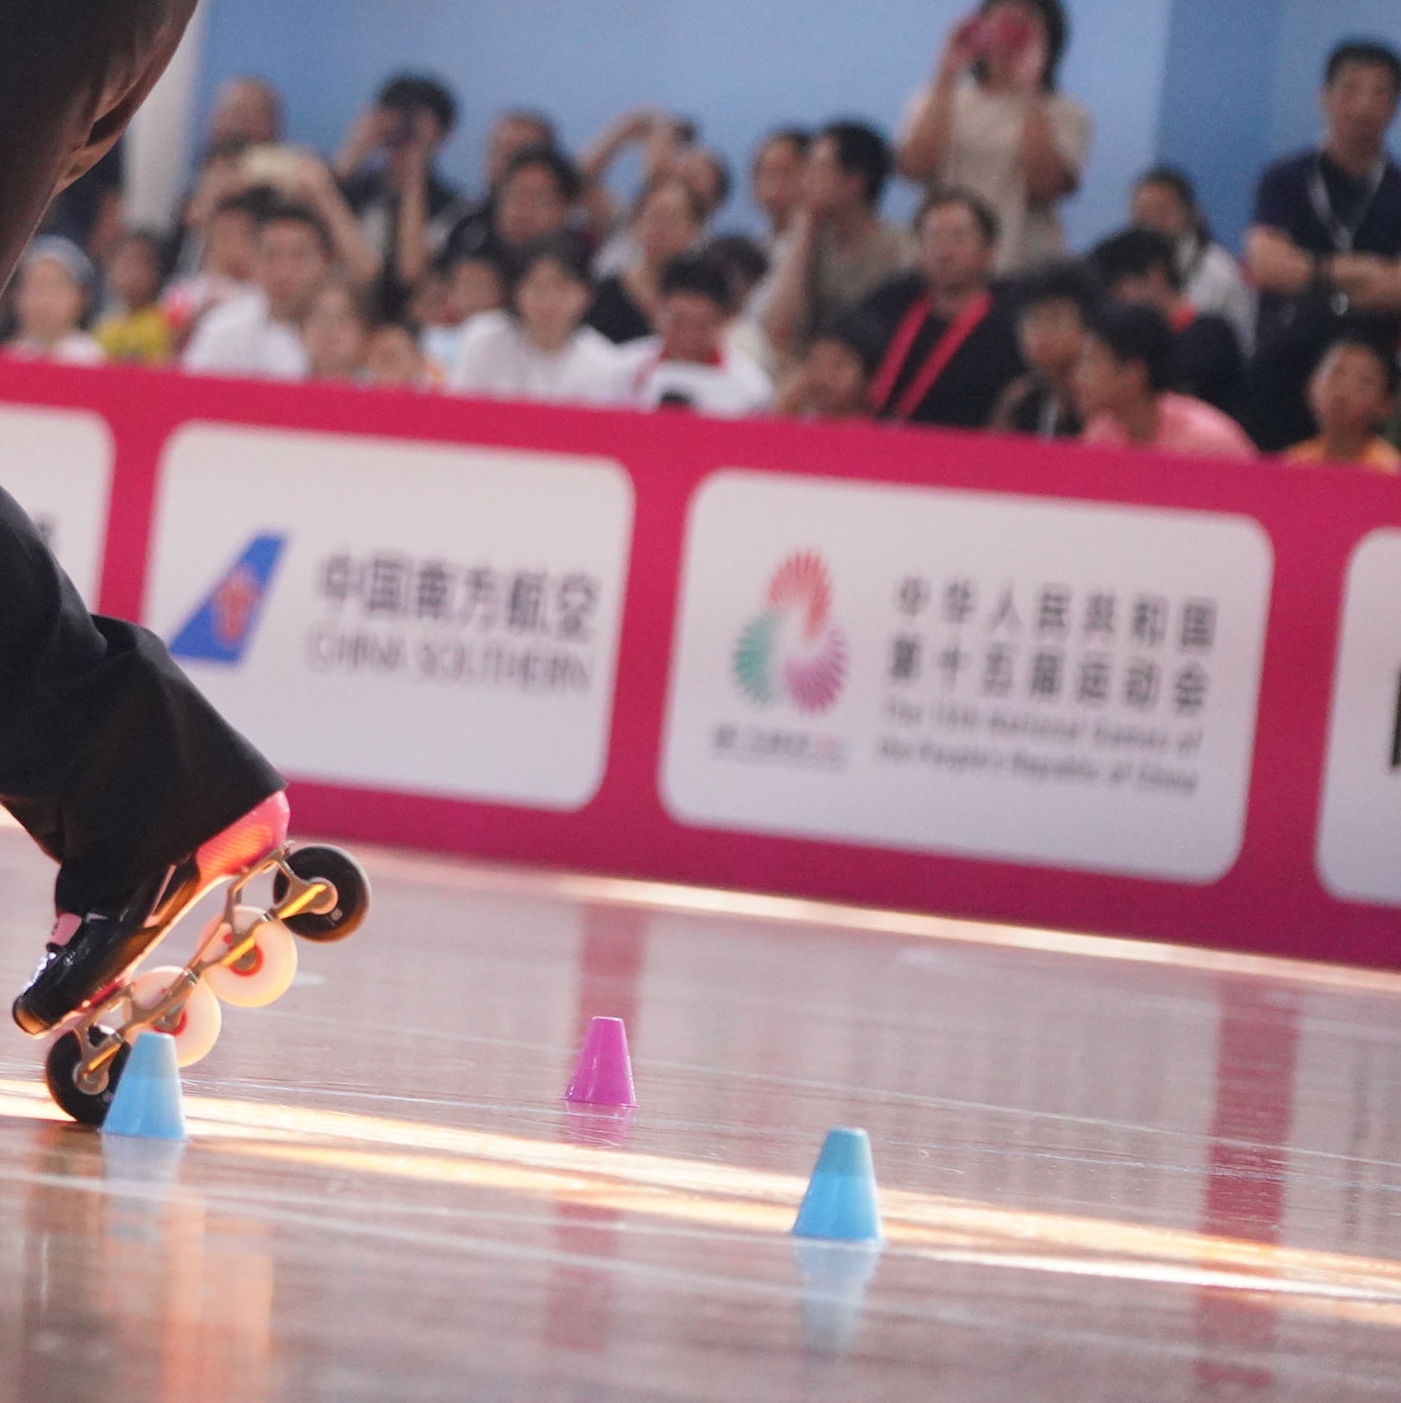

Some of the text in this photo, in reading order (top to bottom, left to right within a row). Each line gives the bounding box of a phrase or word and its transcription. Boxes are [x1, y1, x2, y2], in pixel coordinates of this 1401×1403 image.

[315, 552, 599, 638] 中国南方航空
[894, 575, 1216, 650] 中华人民共和国
[306, 626, 402, 676] CHINA
[889, 632, 1207, 716] 第十五届运动会
